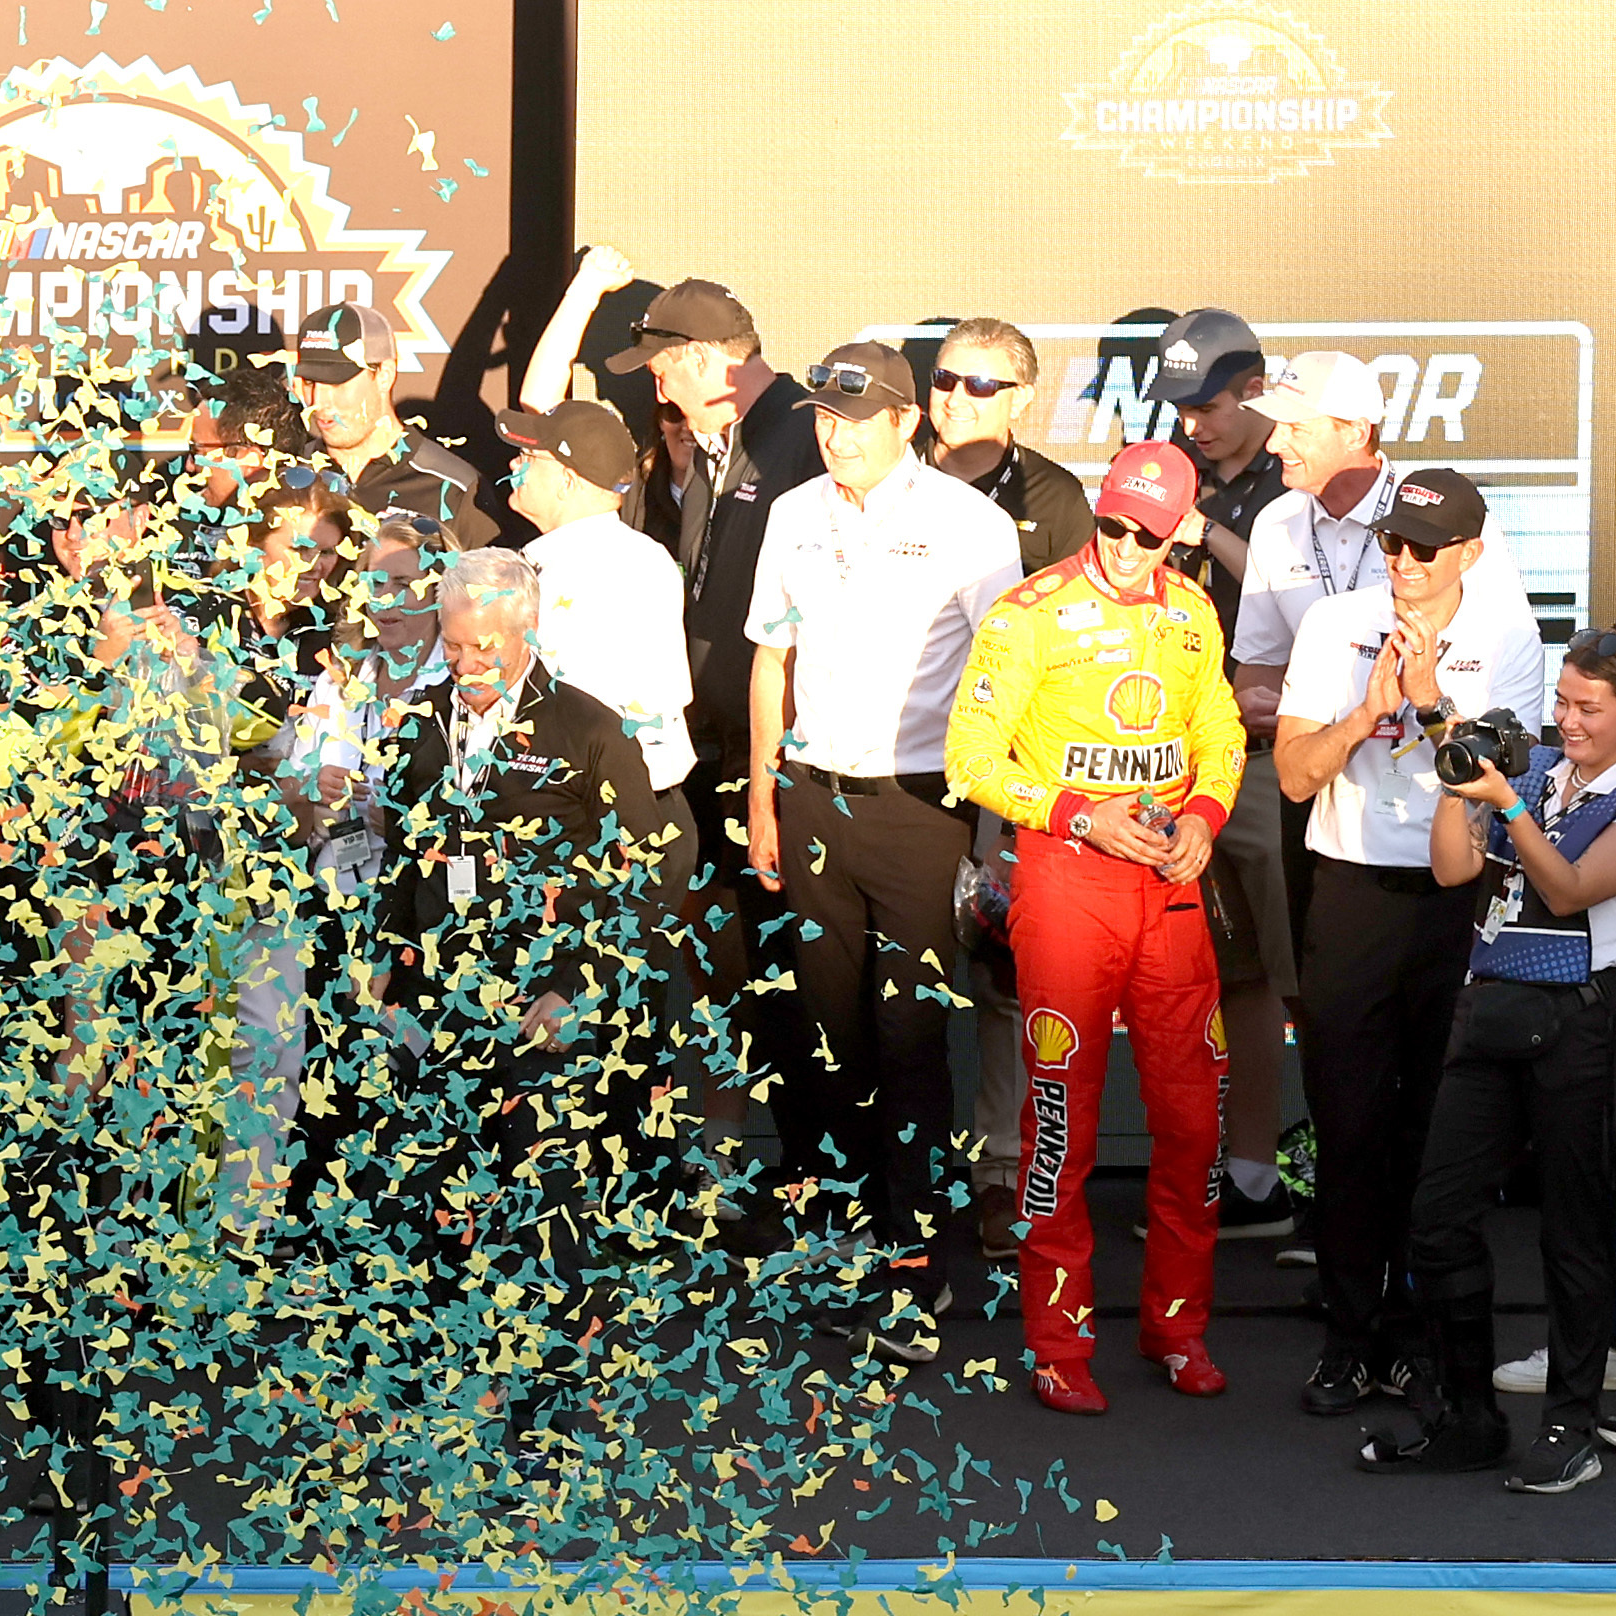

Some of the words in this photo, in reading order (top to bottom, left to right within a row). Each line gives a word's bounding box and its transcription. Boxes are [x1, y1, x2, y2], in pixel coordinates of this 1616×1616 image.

[1096, 98, 1359, 133] CHAMPIONSHIP
[1159, 135, 1295, 150] WEEKEND
[43, 221, 205, 260] NASCAR
[516, 753, 549, 765] TEAM
[1023, 1079, 1066, 1218] PENNZOIL
